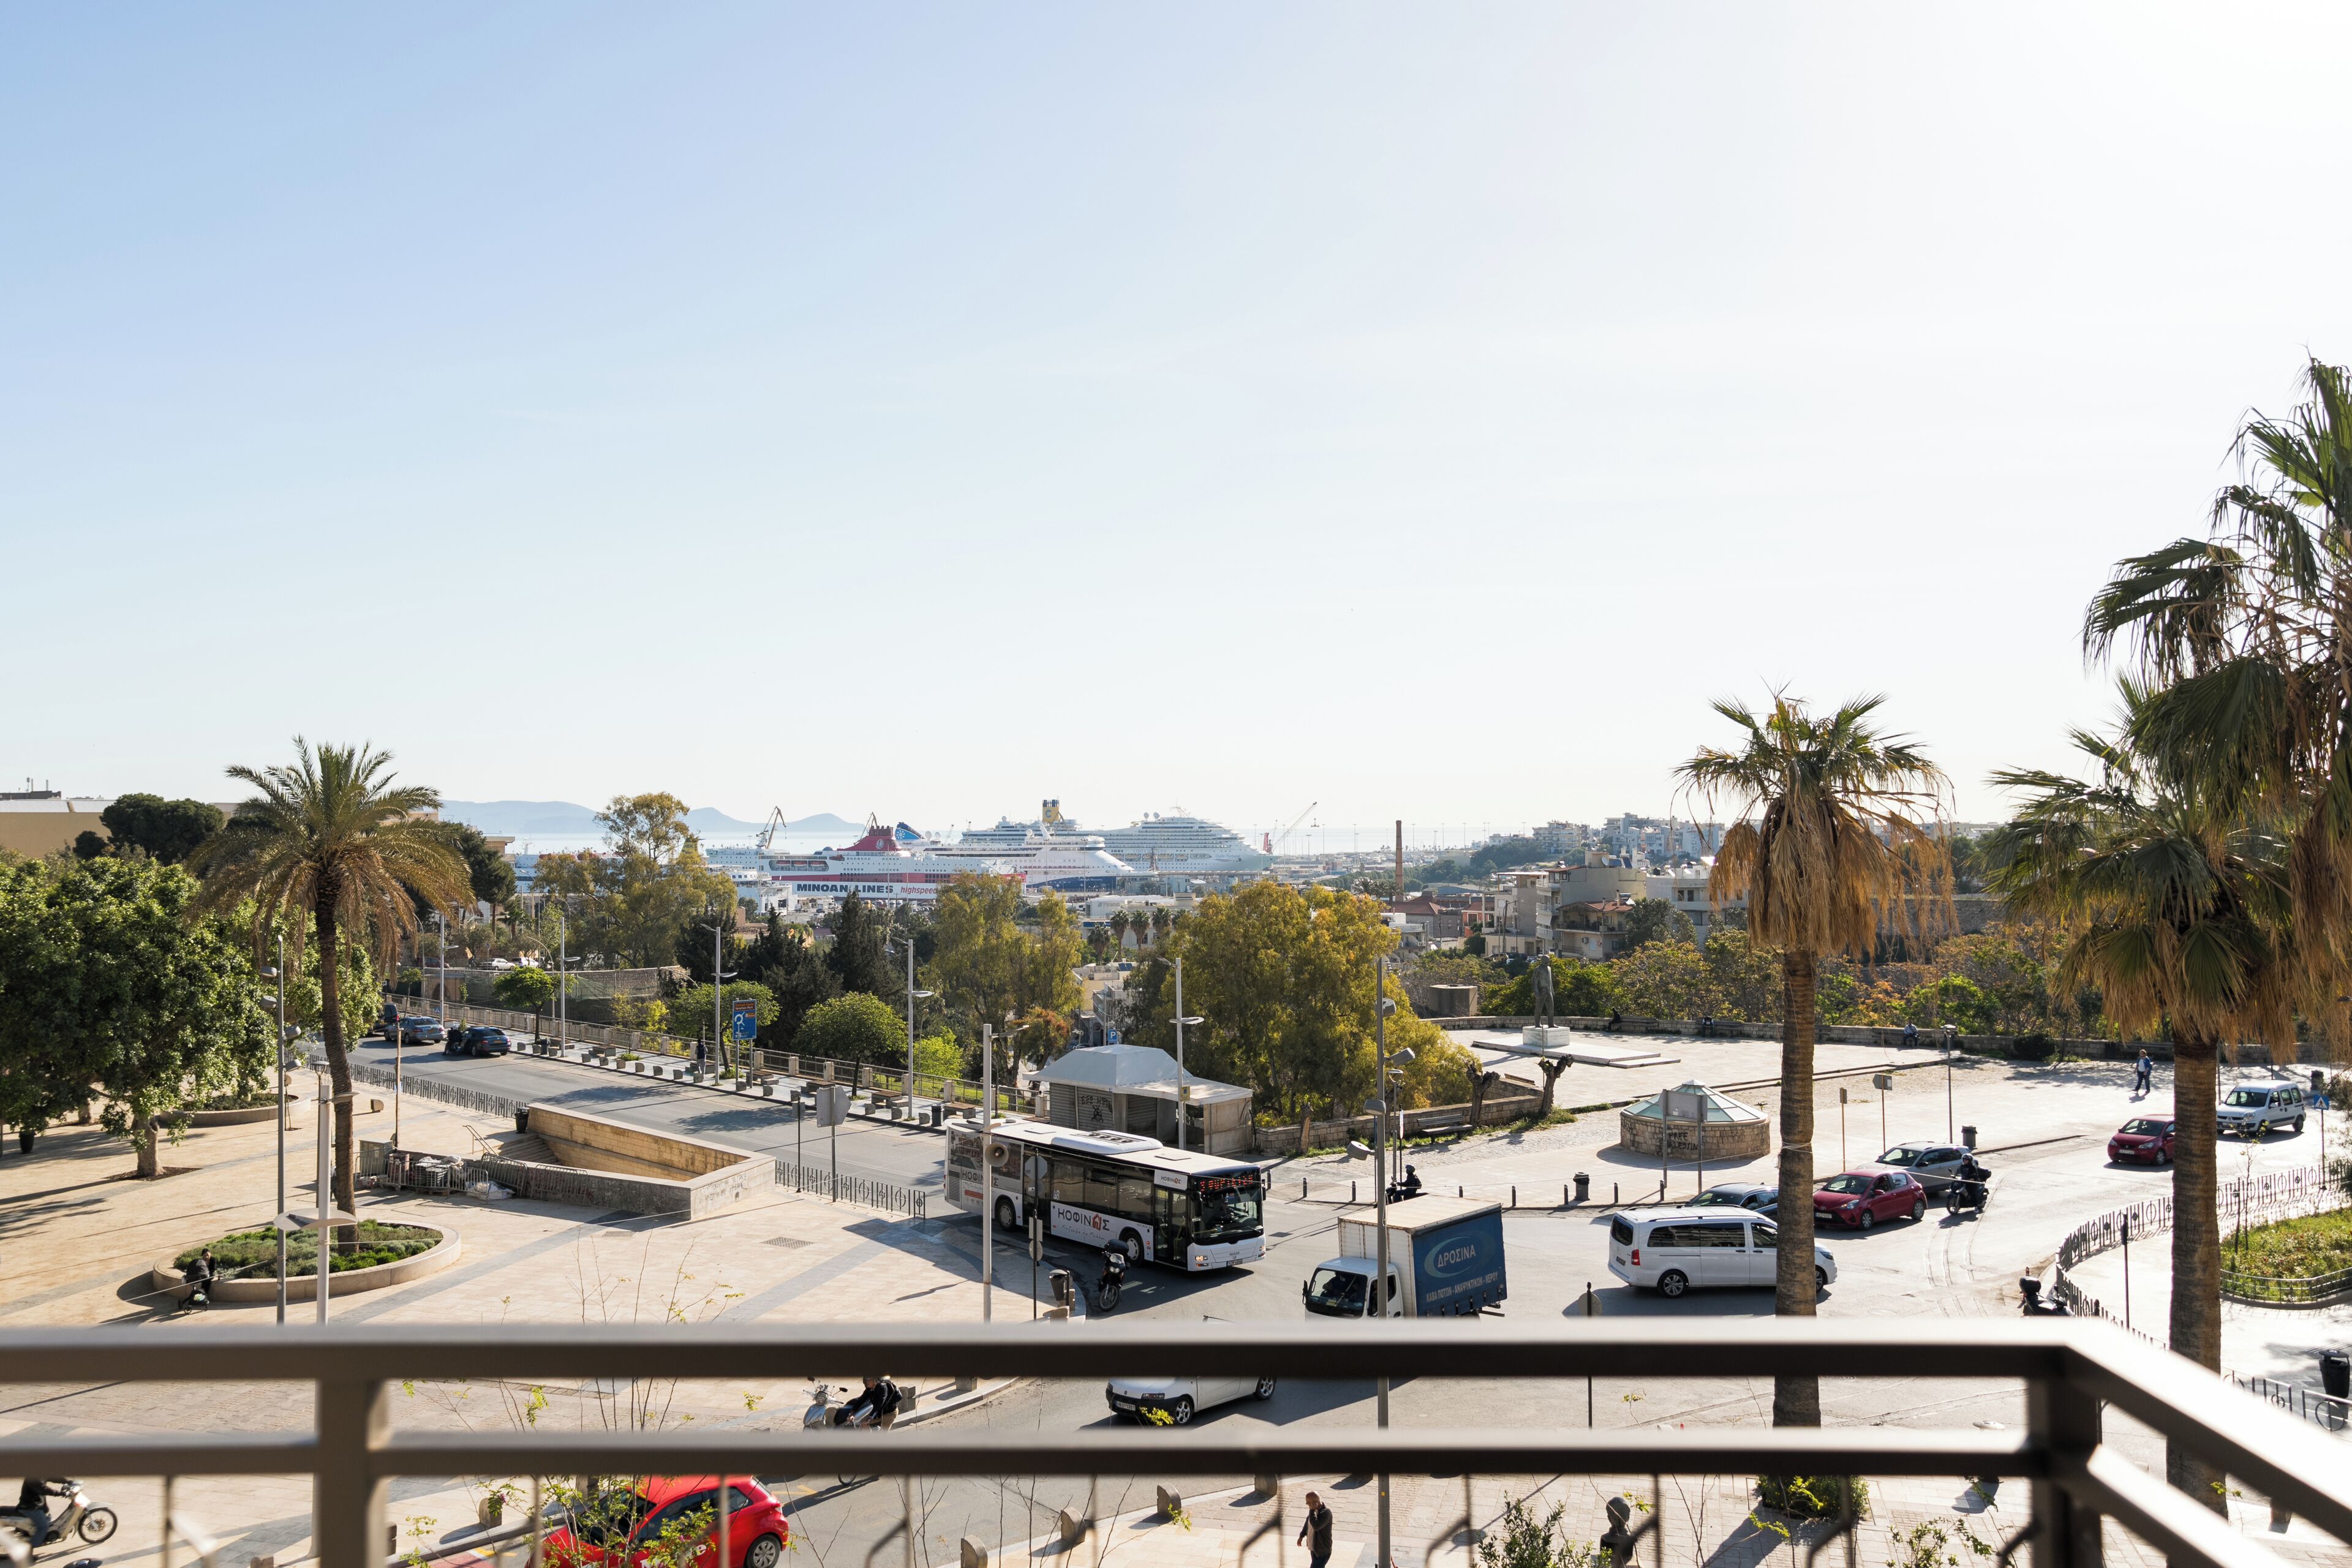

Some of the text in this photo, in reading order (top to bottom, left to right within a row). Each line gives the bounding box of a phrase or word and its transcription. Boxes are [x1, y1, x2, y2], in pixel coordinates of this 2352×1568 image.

[797, 884, 894, 893] MINOAN LINES
[1667, 1141, 1698, 1151] ALESTIN
[1438, 1244, 1476, 1268] ΔΡΟΣΙΝΑ
[1438, 1287, 1452, 1298] ΠΟΤΩΝ
[1455, 1276, 1483, 1294] ΑΝΑΨΥΚΤΙΚΩΝ
[1485, 1272, 1498, 1284] ΝΕΡΟΥ
